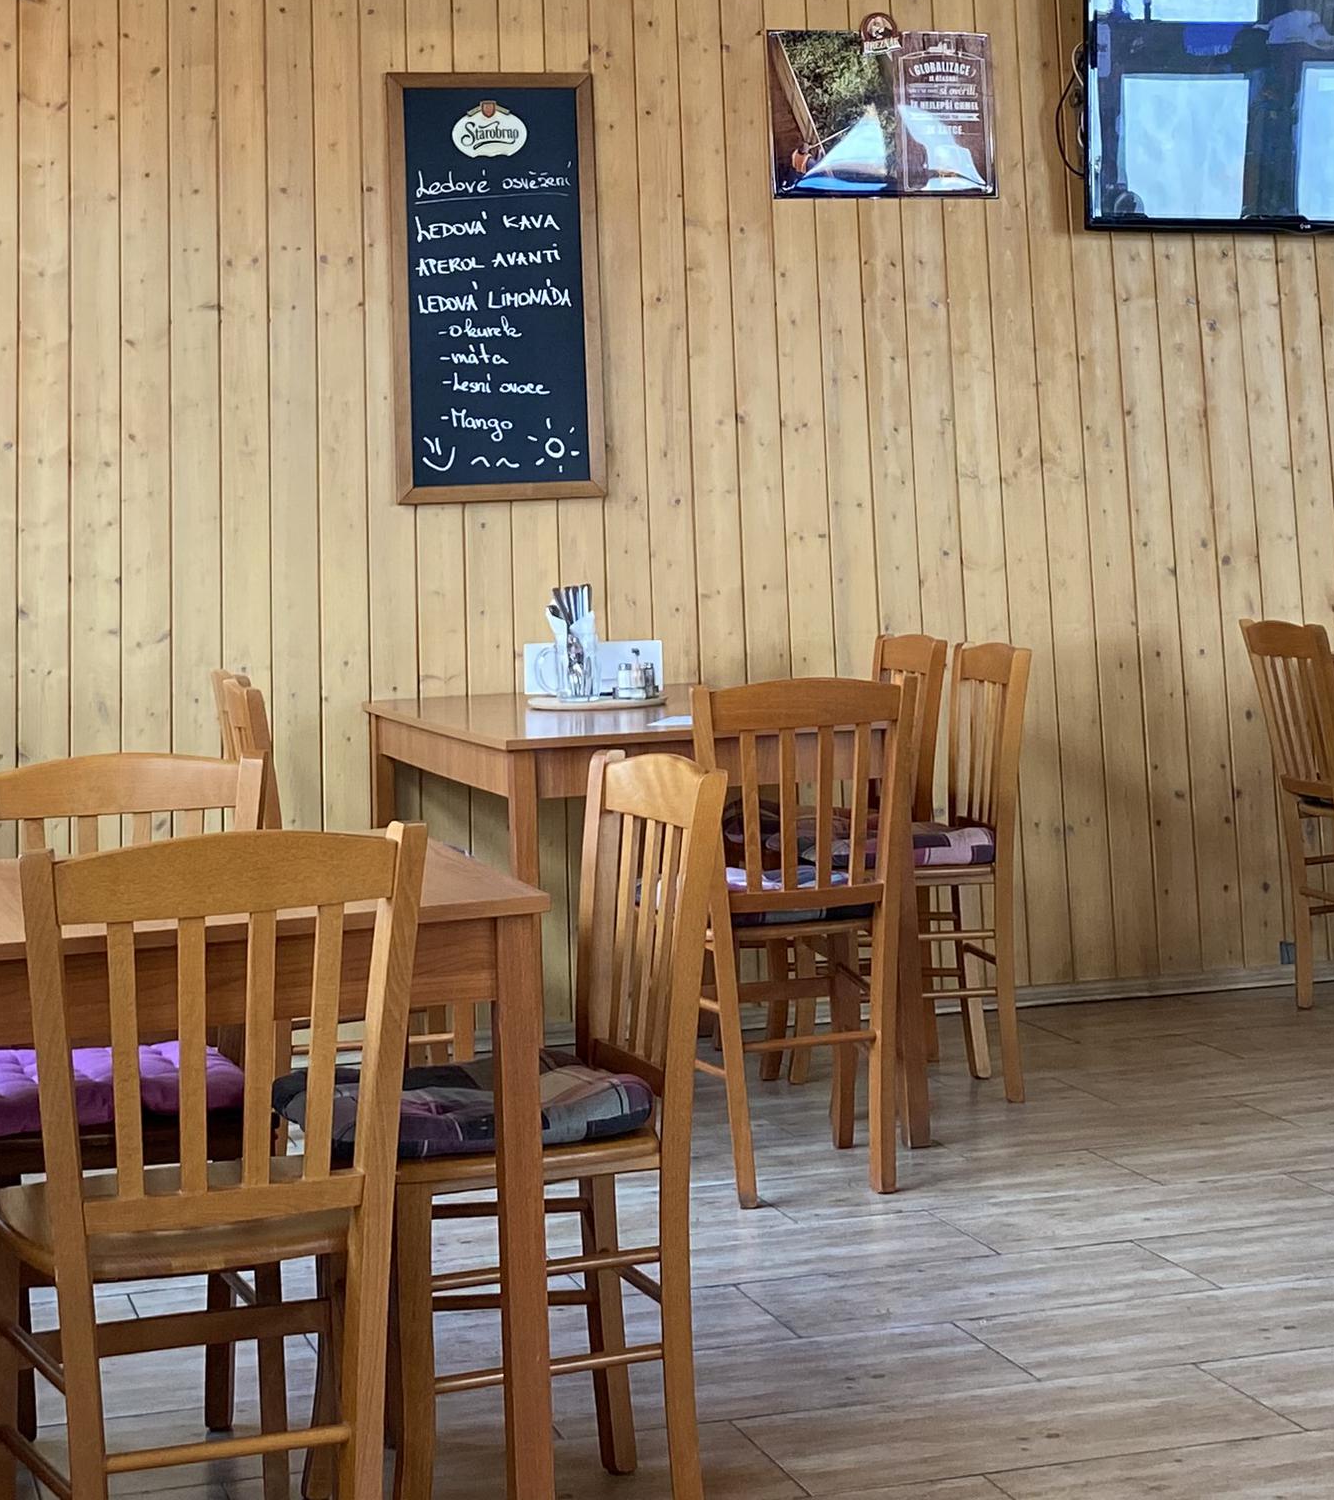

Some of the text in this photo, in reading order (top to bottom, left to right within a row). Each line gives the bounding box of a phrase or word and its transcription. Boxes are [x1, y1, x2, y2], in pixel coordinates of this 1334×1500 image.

[913, 61, 971, 76] GLOBALIZACE
[461, 121, 519, 148] Starobrno
[415, 169, 491, 198] Ledové
[414, 211, 488, 242] LEDOVÁ
[415, 256, 485, 277] APEROL
[417, 278, 572, 314] LEDOVÁ LIMONÁDA
[499, 383, 551, 395] ovoce
